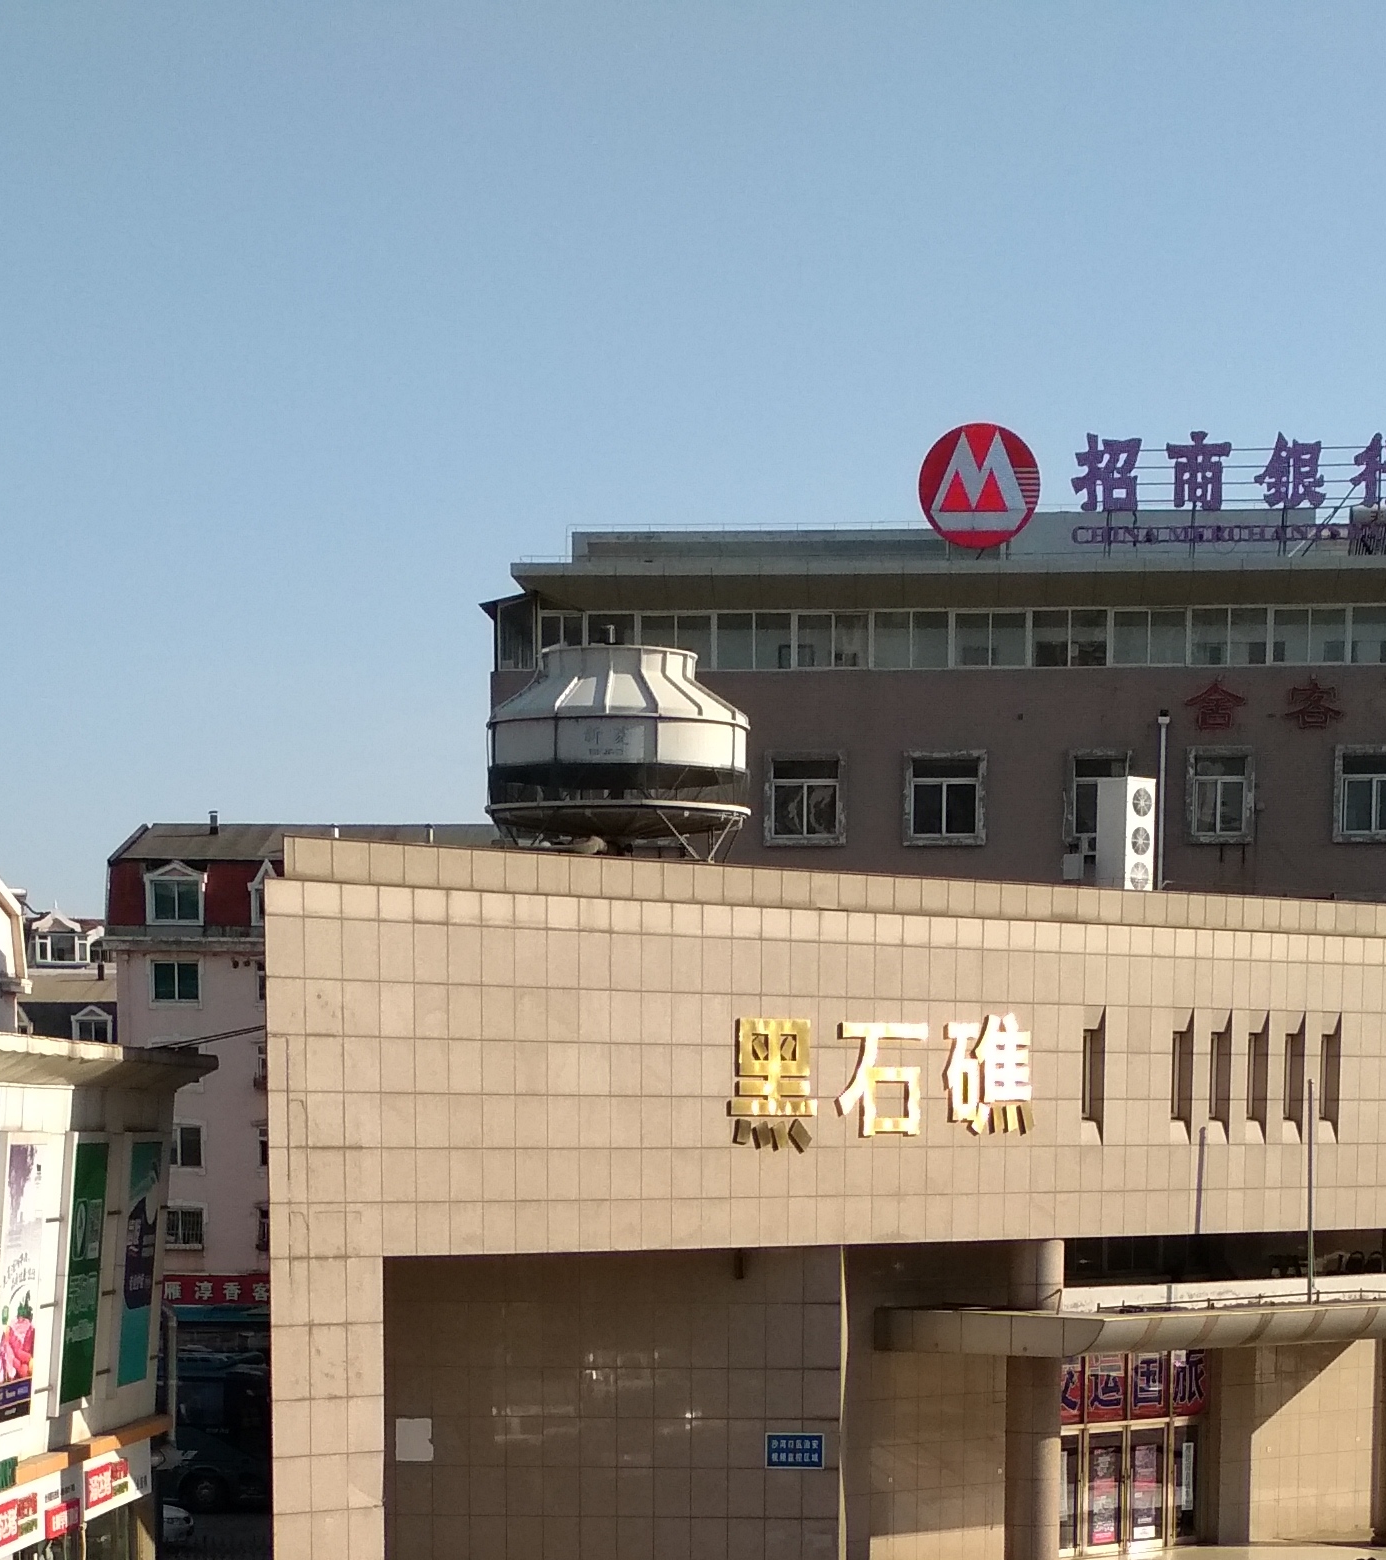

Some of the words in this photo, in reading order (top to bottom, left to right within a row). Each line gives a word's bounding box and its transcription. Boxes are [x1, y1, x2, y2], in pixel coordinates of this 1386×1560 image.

[1072, 526, 1158, 544] CHINA
[726, 1012, 1035, 1154] 黑石礁
[771, 1439, 819, 1449] 沙河口区治安
